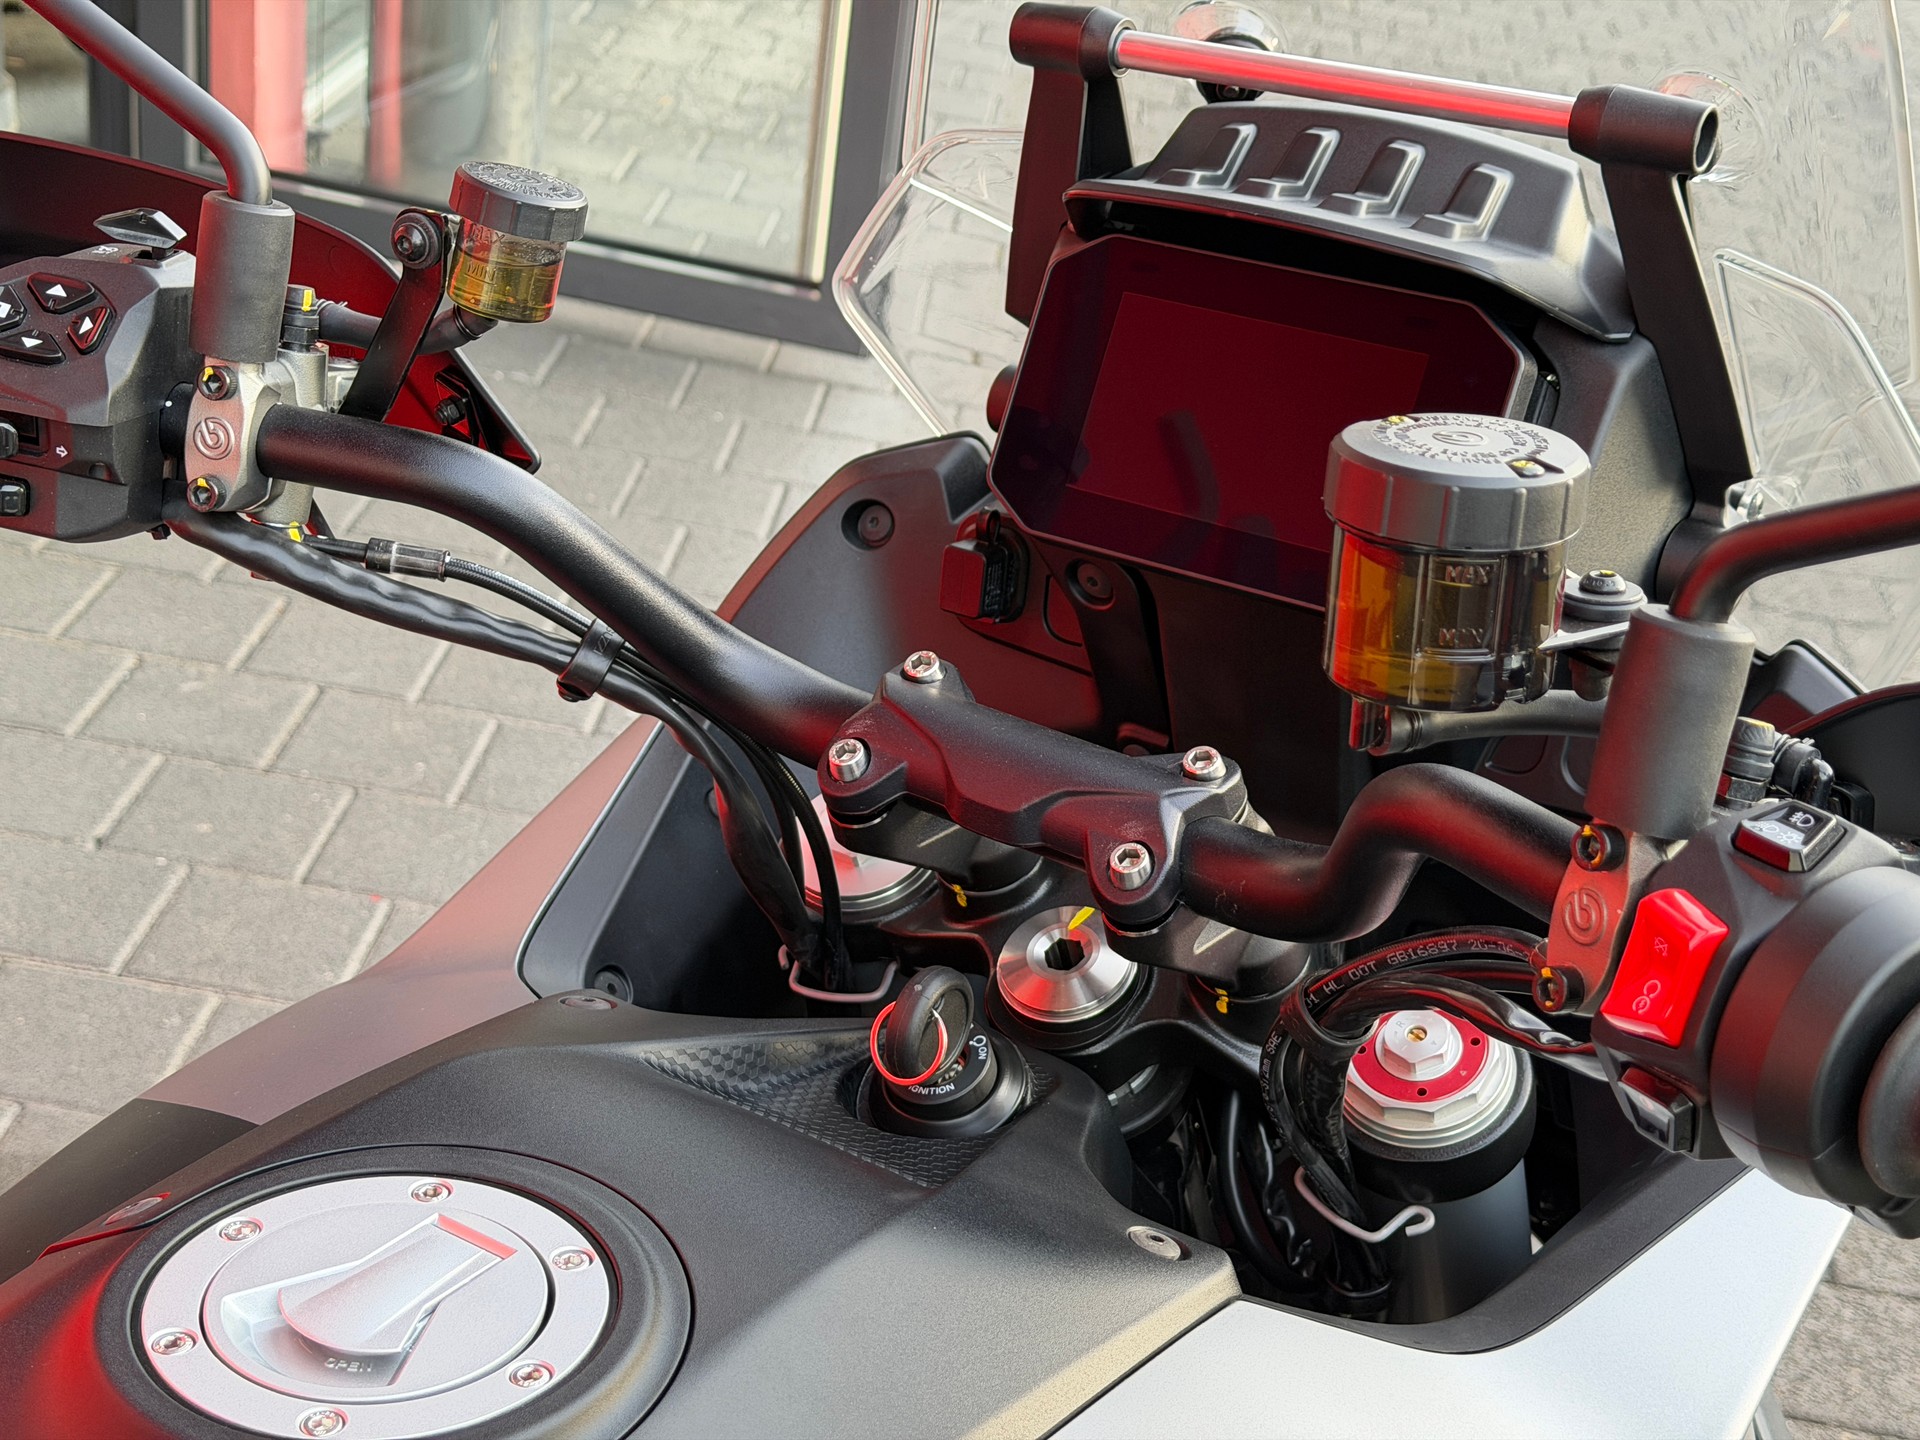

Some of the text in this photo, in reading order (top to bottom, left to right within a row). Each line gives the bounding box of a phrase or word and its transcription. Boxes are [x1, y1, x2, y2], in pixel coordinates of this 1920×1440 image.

[466, 260, 497, 282] MIN
[1322, 979, 1345, 995] HL
[978, 1046, 987, 1060] ON
[323, 1357, 373, 1372] OPEN
